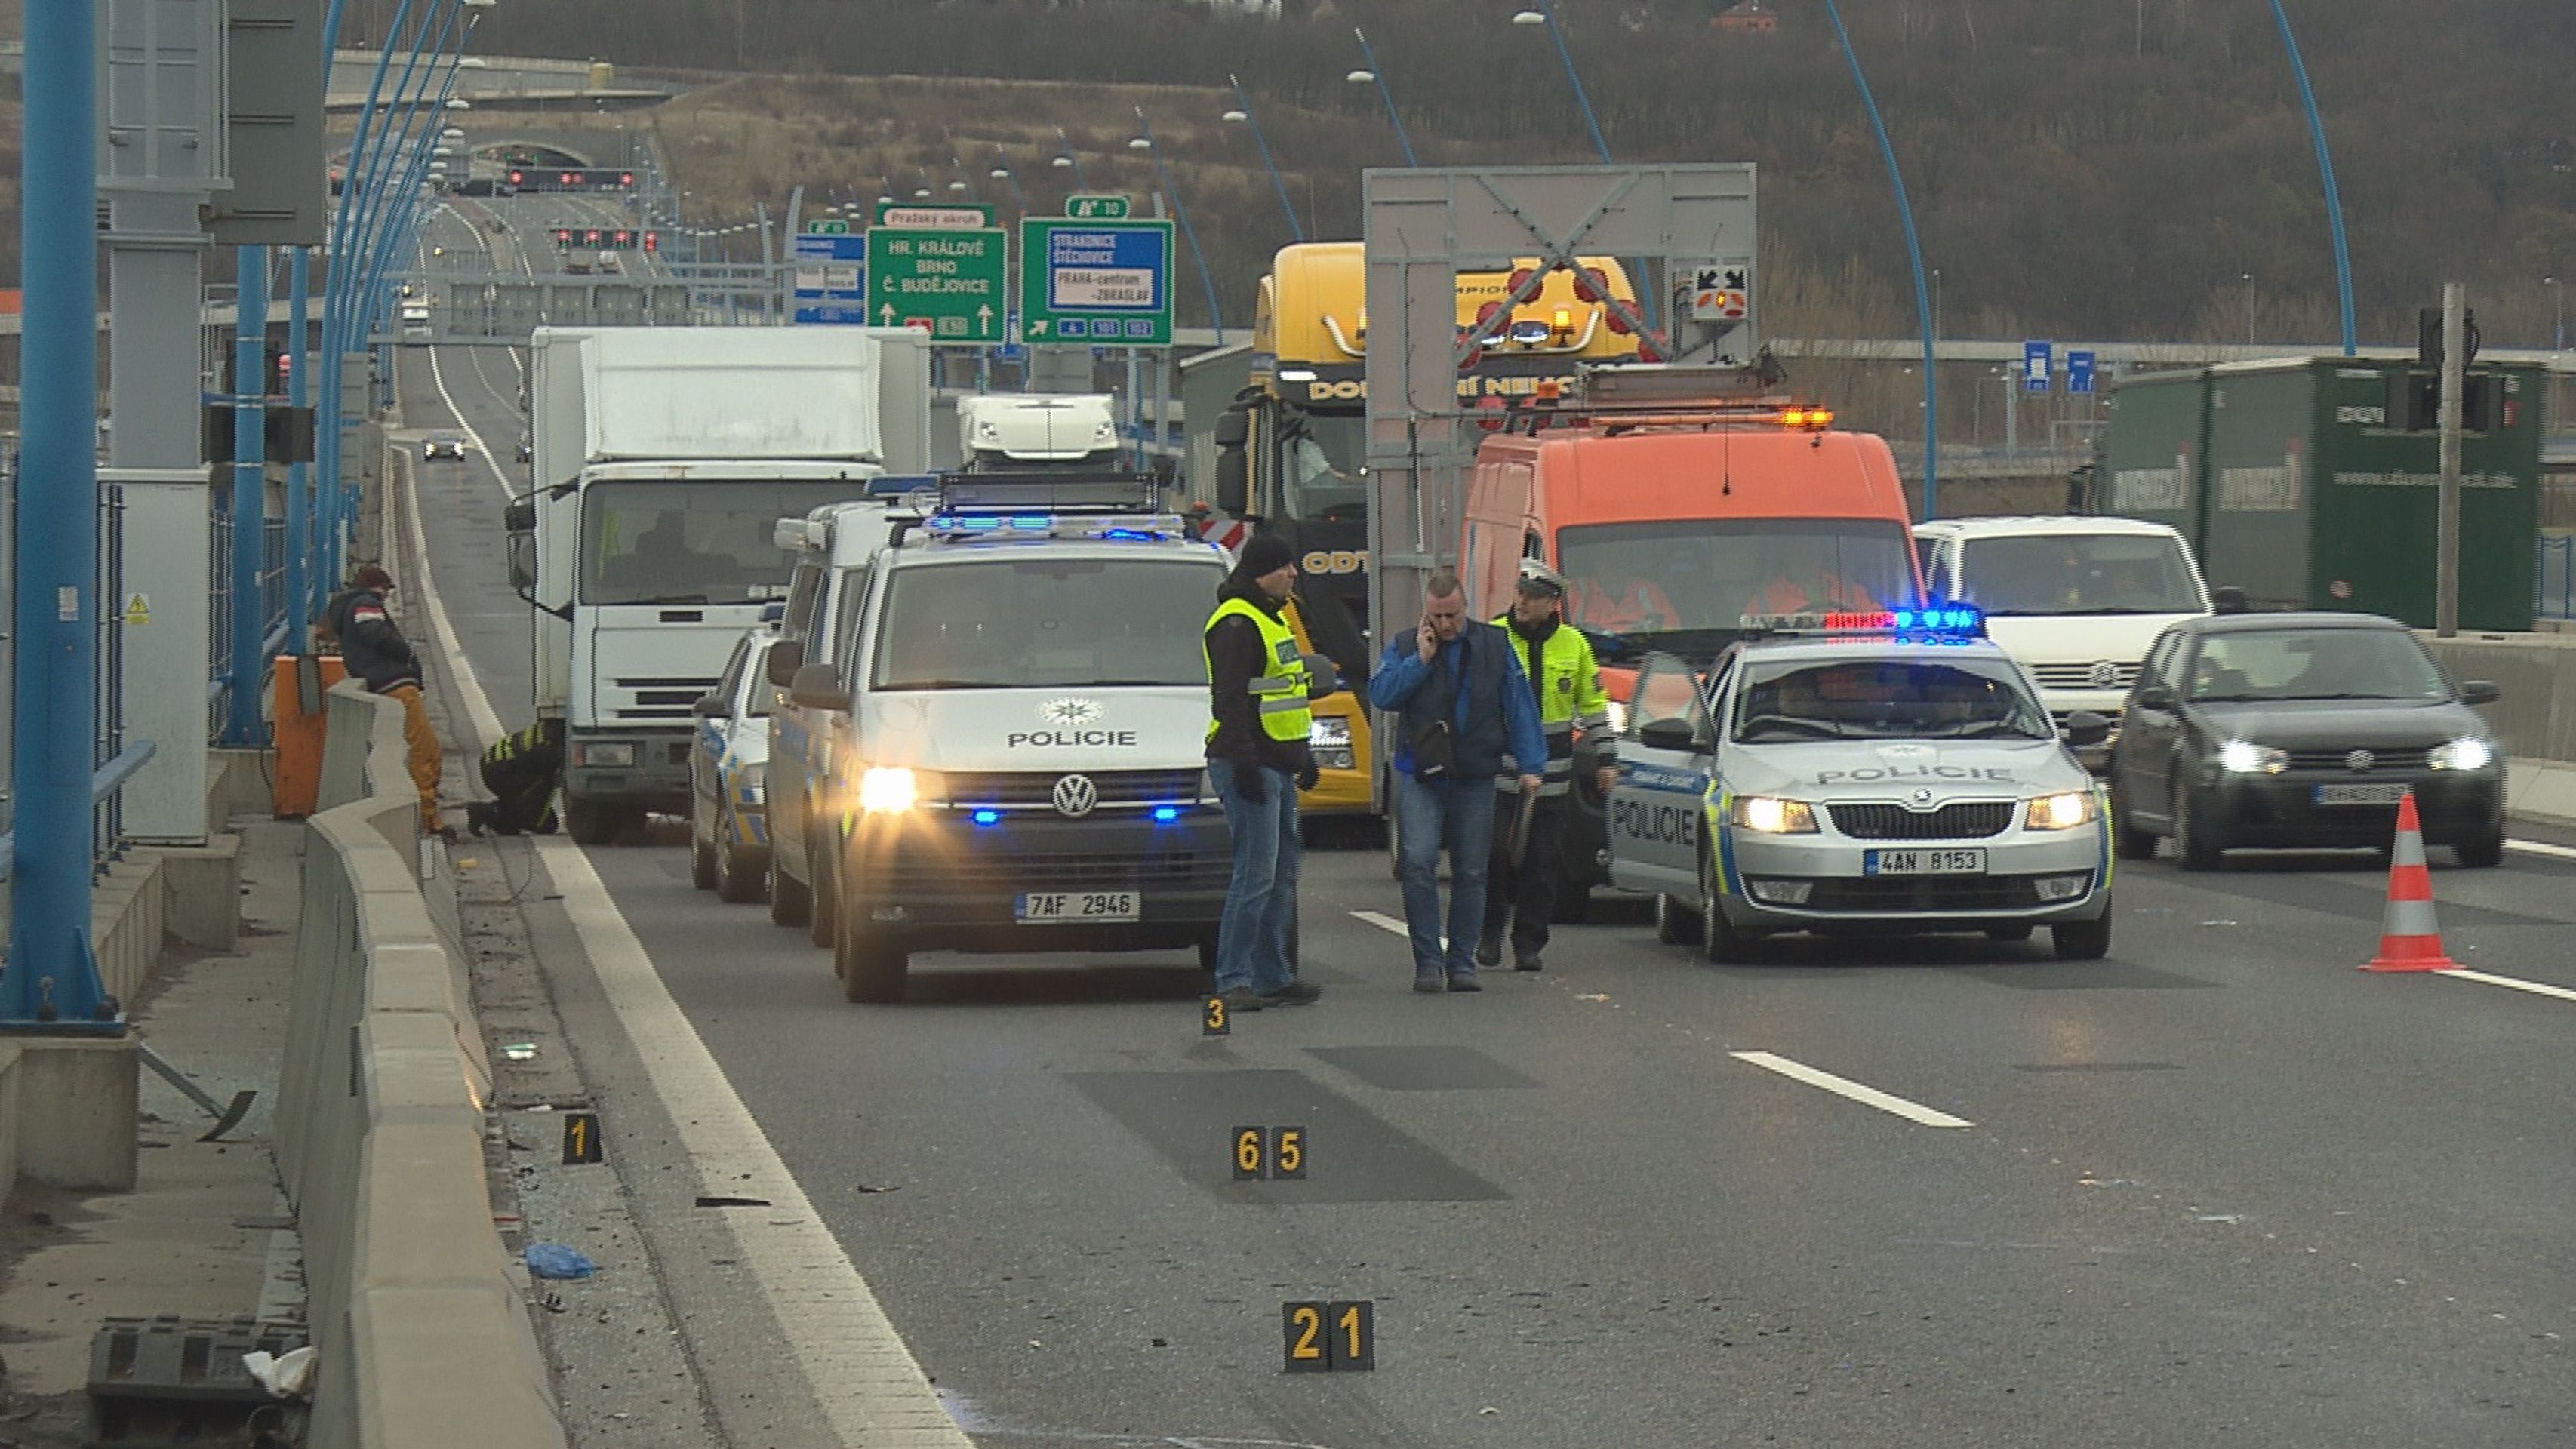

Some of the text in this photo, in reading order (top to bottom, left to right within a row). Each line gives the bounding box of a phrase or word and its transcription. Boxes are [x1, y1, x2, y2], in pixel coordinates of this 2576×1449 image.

[888, 238, 985, 257] HR. KRÁLOVÉ
[916, 259, 958, 274] BRNO
[901, 275, 990, 294] BUDĚJOVICE
[1008, 731, 1138, 748] POLICIE
[1817, 764, 2017, 786] POLICIE
[1612, 798, 1695, 847] POLICIE
[1882, 851, 1977, 872] 4AN 8153
[1031, 894, 1131, 915] 7AF 2946
[1208, 998, 1224, 1029] 3
[571, 1118, 586, 1157] 1
[1238, 1131, 1300, 1171] 6 5
[1291, 1306, 1359, 1360] 2 1
